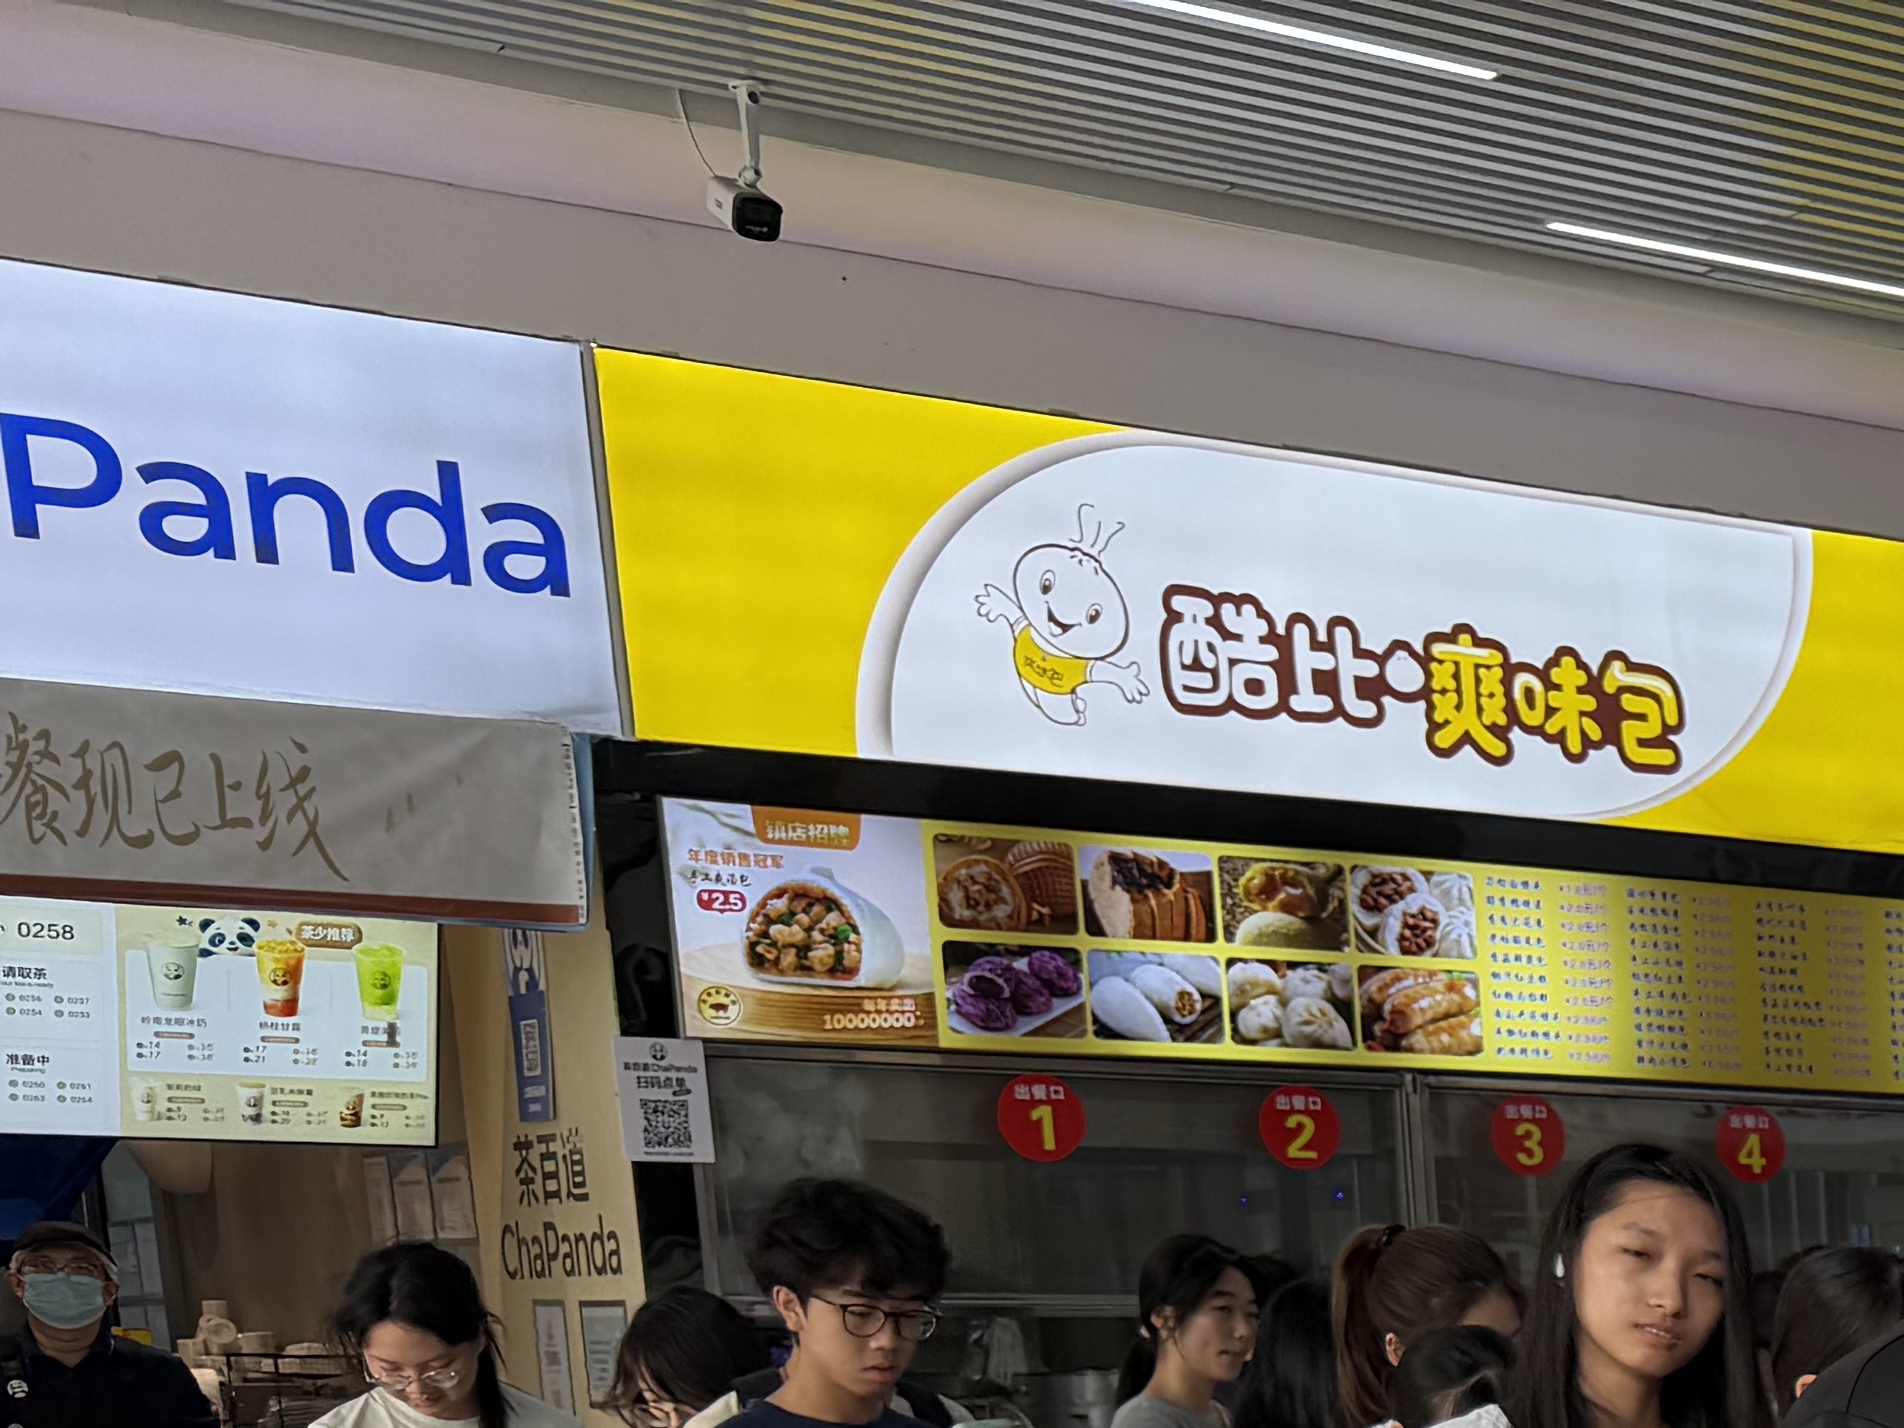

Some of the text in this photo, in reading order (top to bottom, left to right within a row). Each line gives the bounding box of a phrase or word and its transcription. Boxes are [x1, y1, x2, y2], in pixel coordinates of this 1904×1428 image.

[0, 413, 572, 598] Panda
[0, 712, 350, 882] 餐现已上线
[765, 820, 850, 846] 镇店招牌
[17, 921, 75, 941] 0258
[6, 1053, 50, 1066] 准备中
[1014, 1084, 1065, 1100] 出餐口
[1275, 1095, 1322, 1111] 出餐口
[1505, 1103, 1548, 1120] 出餐口
[1031, 1105, 1056, 1151] 1
[1285, 1114, 1318, 1160] 2
[1730, 1113, 1770, 1130] 出餐口
[1515, 1122, 1545, 1167] 3
[1737, 1134, 1766, 1174] 4
[513, 1127, 590, 1208] 茶百道
[502, 1214, 623, 1282] ChaPanda
